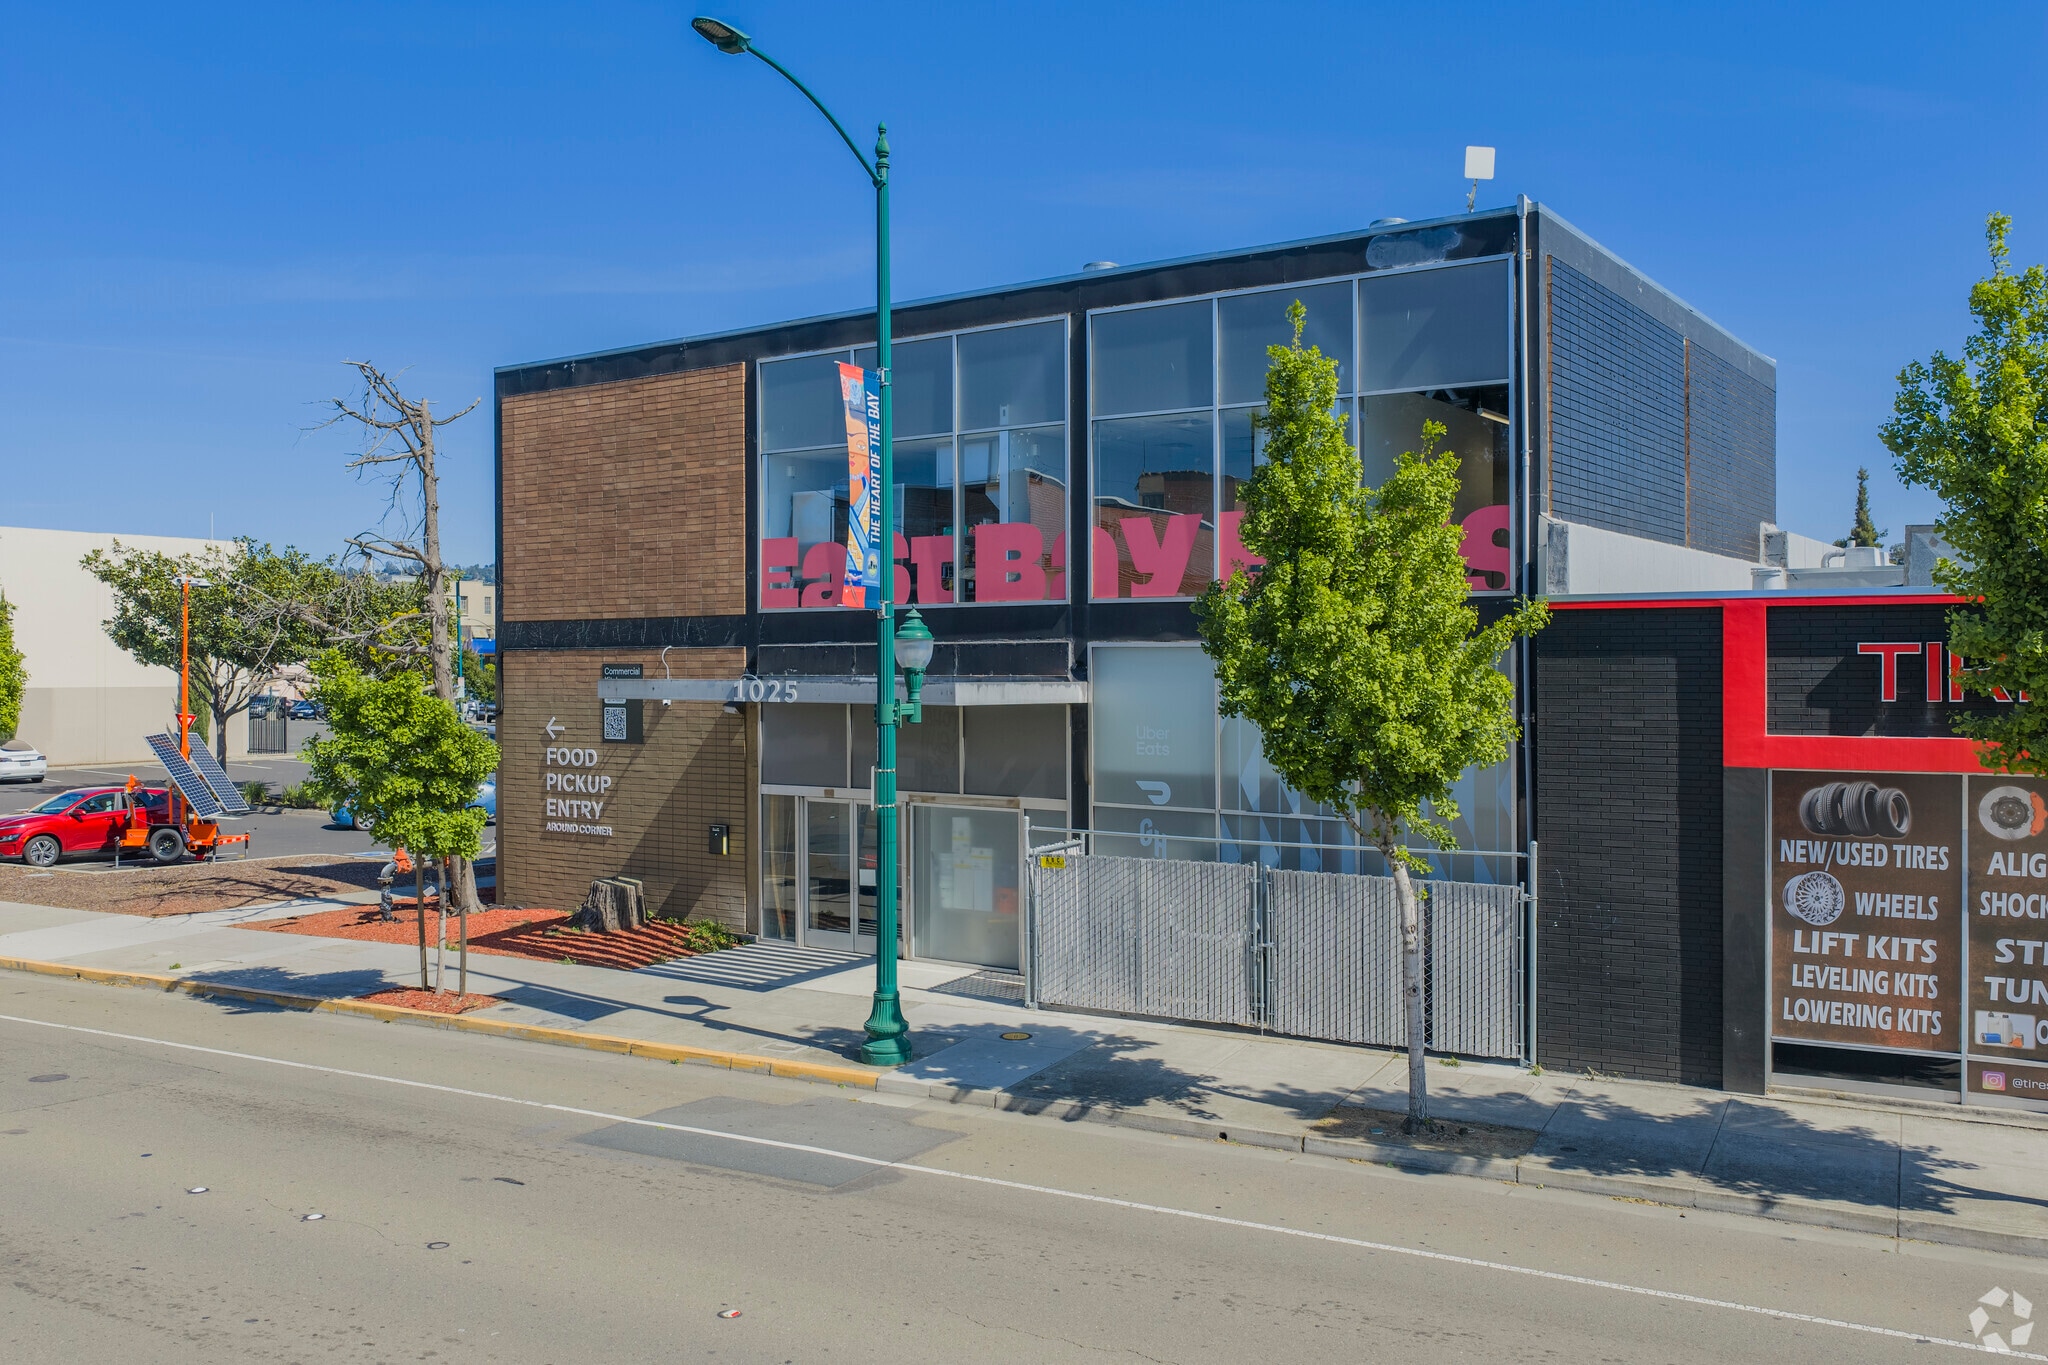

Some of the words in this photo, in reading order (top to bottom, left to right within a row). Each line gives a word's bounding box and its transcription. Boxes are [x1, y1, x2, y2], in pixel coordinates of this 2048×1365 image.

[866, 390, 880, 419] BAY
[869, 421, 880, 446] THE
[870, 450, 880, 468] OF
[870, 470, 880, 515] HEART
[870, 518, 880, 543] THE
[604, 666, 641, 676] Commercial
[1857, 641, 2031, 702] TIR
[733, 679, 798, 703] 1025
[1136, 725, 1170, 740] Uber
[546, 747, 598, 767] FOOD
[1136, 741, 1170, 756] Eats
[546, 773, 612, 794] PICKUP
[546, 798, 604, 820] ENTRY
[546, 821, 579, 833] AROUND
[579, 824, 613, 836] CORNER
[1780, 839, 1889, 872] NEW/USED
[1892, 844, 1949, 871] TIRES
[1986, 851, 2047, 878] ALIG
[1854, 892, 1938, 921] WHEELS
[1793, 929, 1860, 957] LIFT
[1867, 935, 1938, 964] KITS
[1792, 963, 1889, 995] LEVELING
[1893, 972, 1939, 999] KITS
[1984, 975, 2048, 1006] TUN
[1783, 997, 1892, 1030] LOWERING
[1897, 1007, 1942, 1035] KITS
